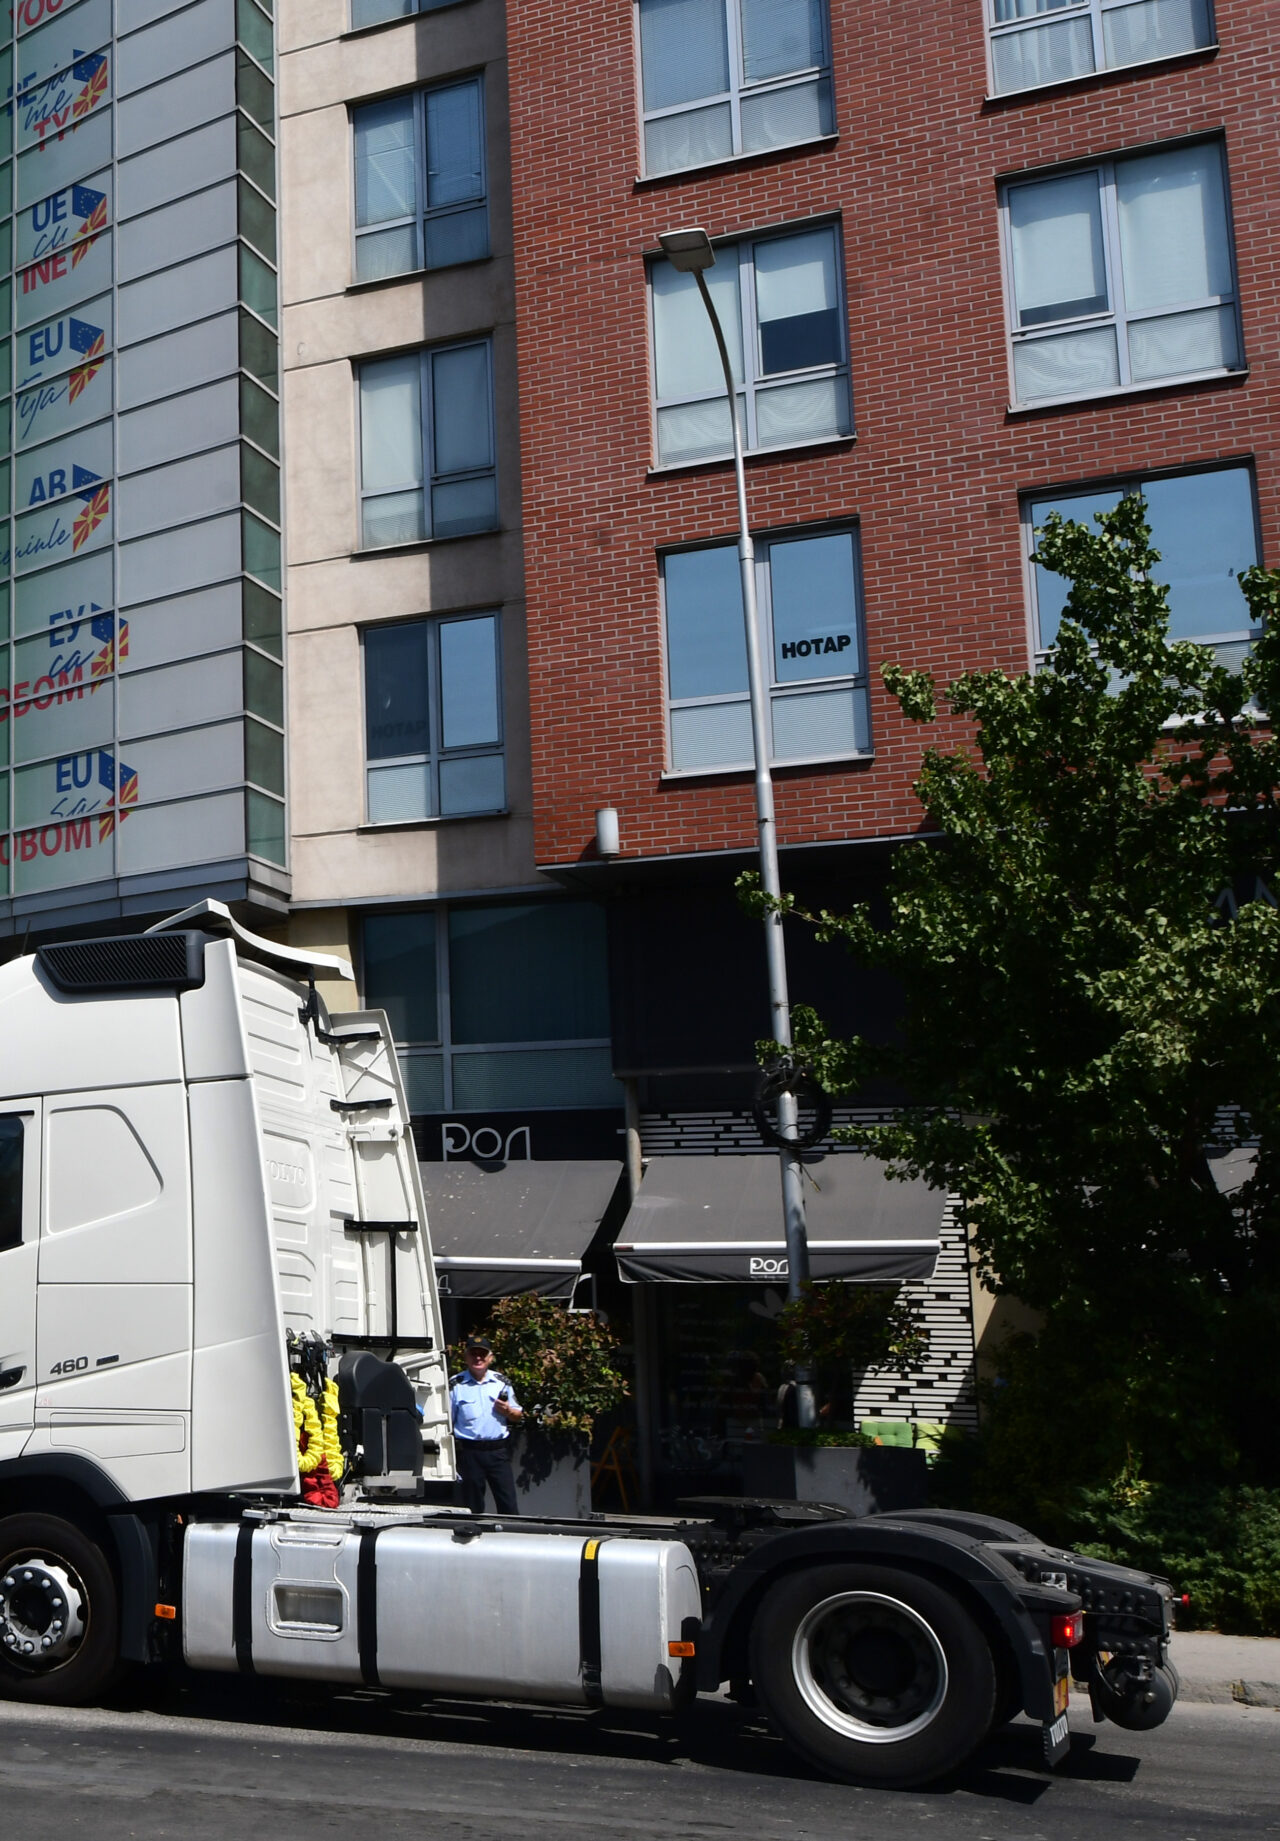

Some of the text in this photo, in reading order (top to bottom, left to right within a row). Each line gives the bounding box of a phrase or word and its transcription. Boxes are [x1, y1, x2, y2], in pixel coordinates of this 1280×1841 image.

[33, 106, 71, 152] TY
[32, 189, 68, 232] UE
[29, 321, 64, 366] EU
[56, 751, 92, 794] EU
[49, 1355, 89, 1376] 460
